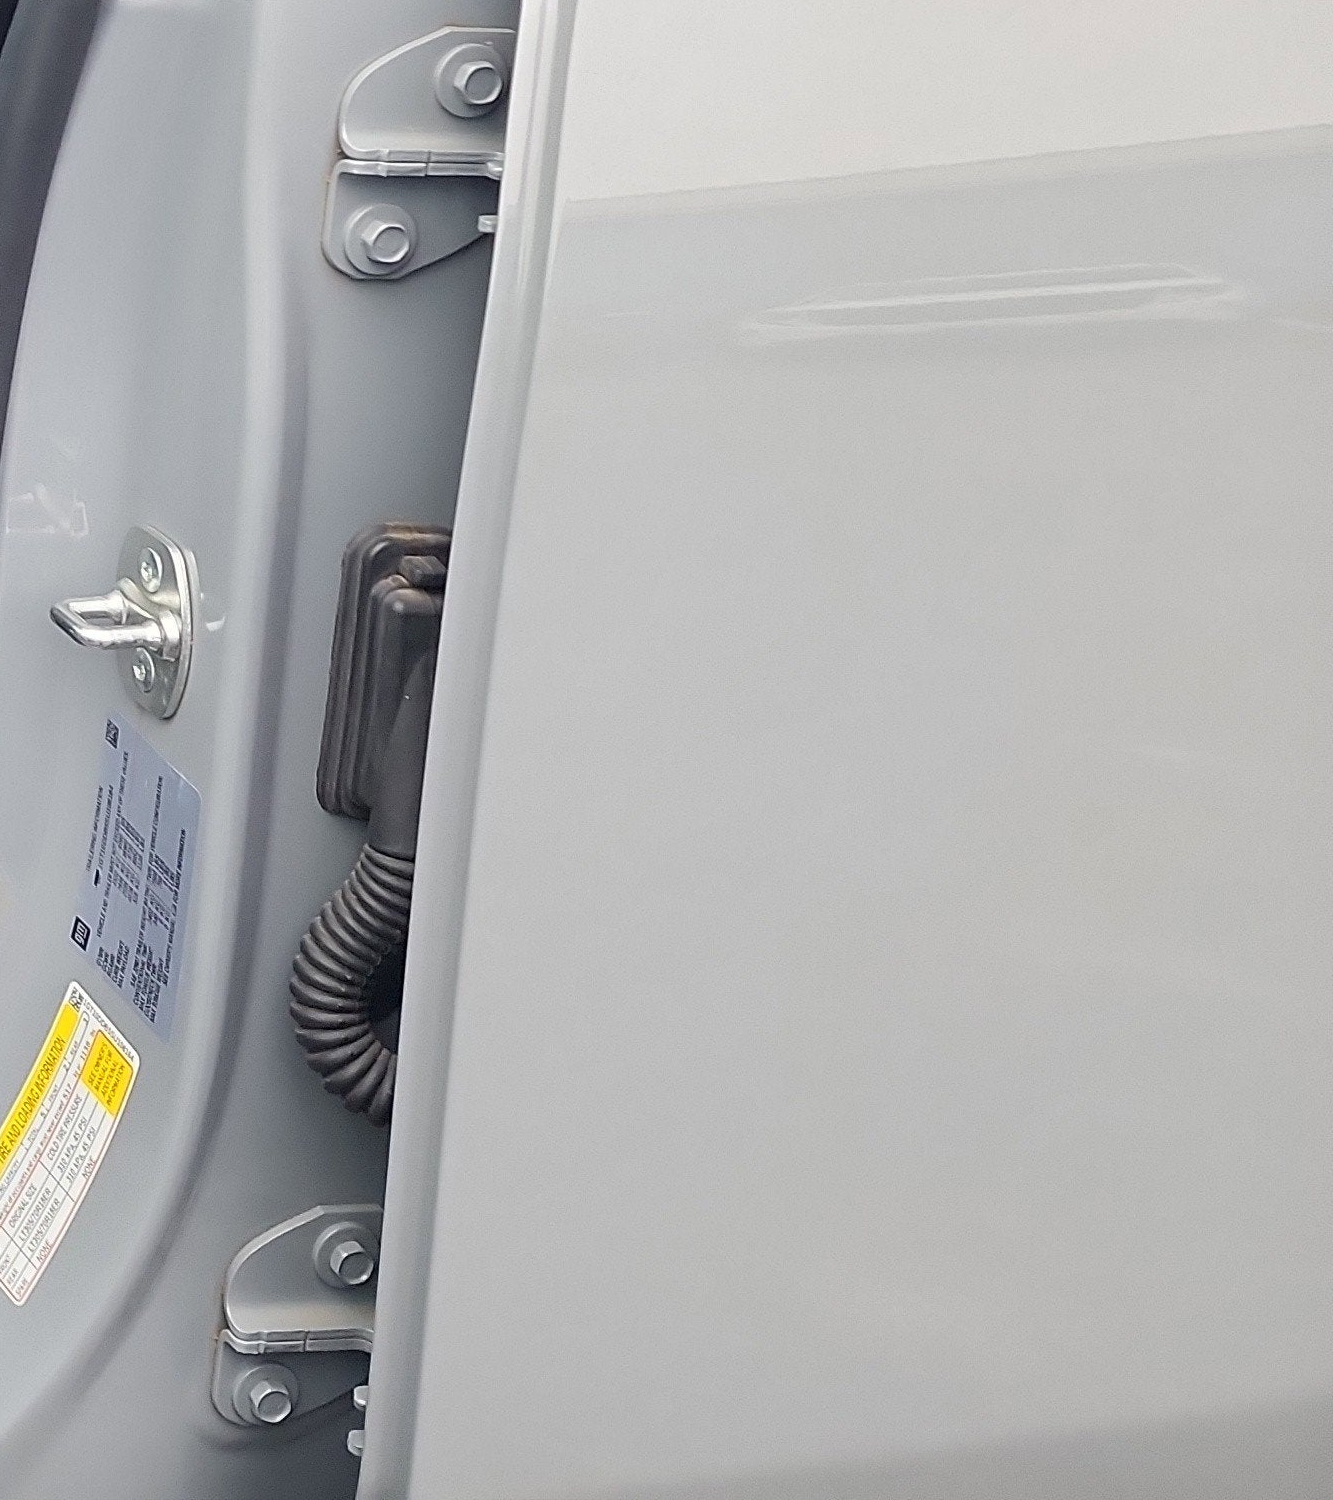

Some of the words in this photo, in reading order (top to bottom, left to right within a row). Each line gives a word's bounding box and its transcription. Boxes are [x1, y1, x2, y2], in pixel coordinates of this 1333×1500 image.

[5, 1122, 21, 1147] AND
[15, 1087, 39, 1129] LOADING
[34, 1035, 66, 1093] INFORMATION
